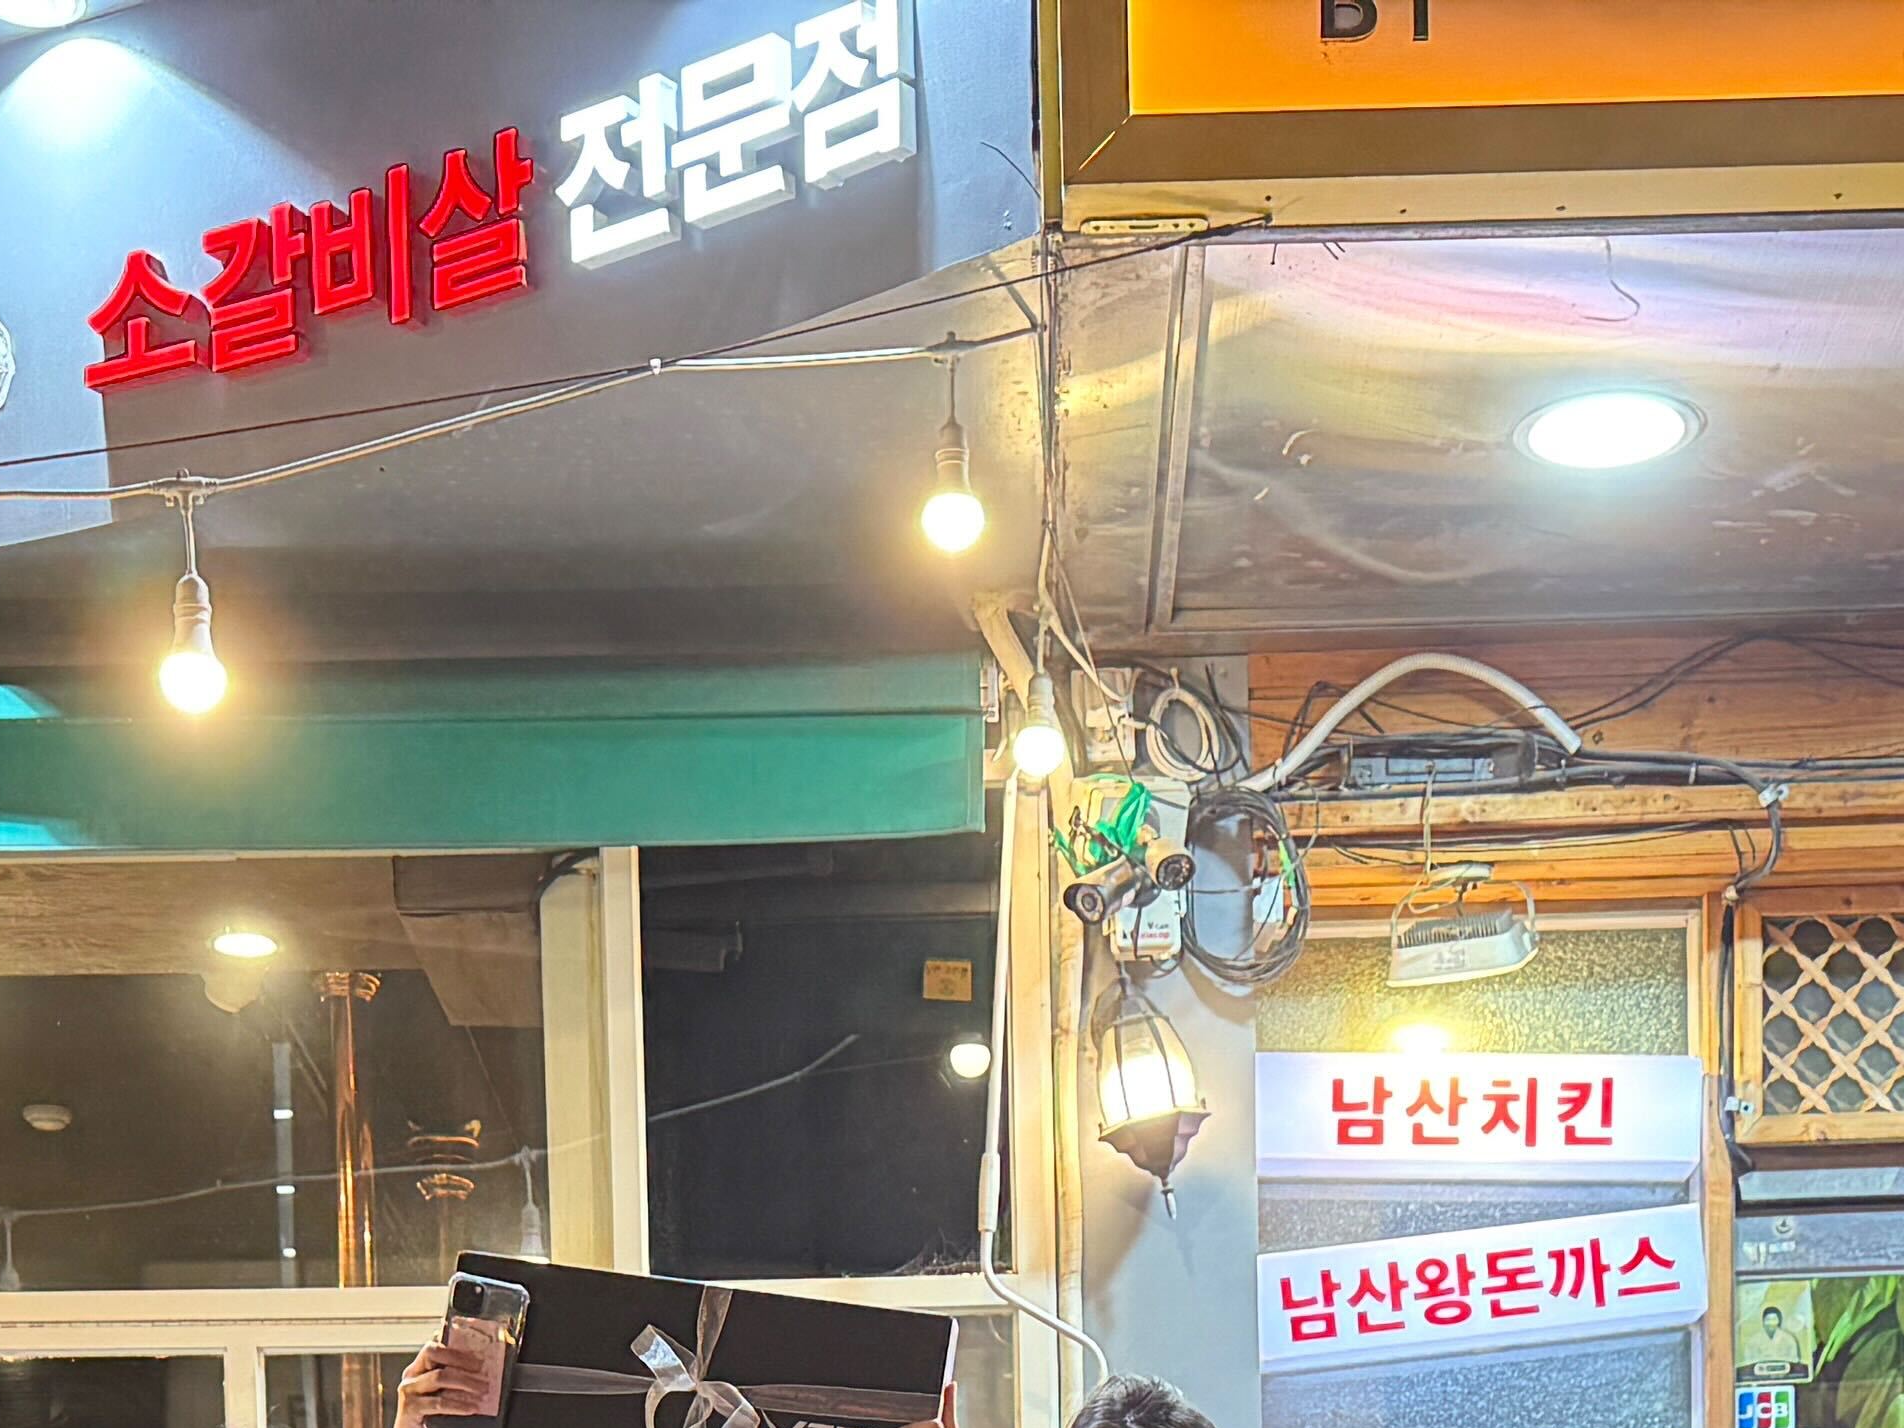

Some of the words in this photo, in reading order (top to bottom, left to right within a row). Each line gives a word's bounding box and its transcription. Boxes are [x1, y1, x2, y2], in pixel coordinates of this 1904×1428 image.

[83, 126, 533, 392] 소갈비살
[555, 0, 916, 269] 전문점
[1332, 1077, 1614, 1147] 남산치킨
[1281, 1236, 1680, 1342] 남산왕돈까스
